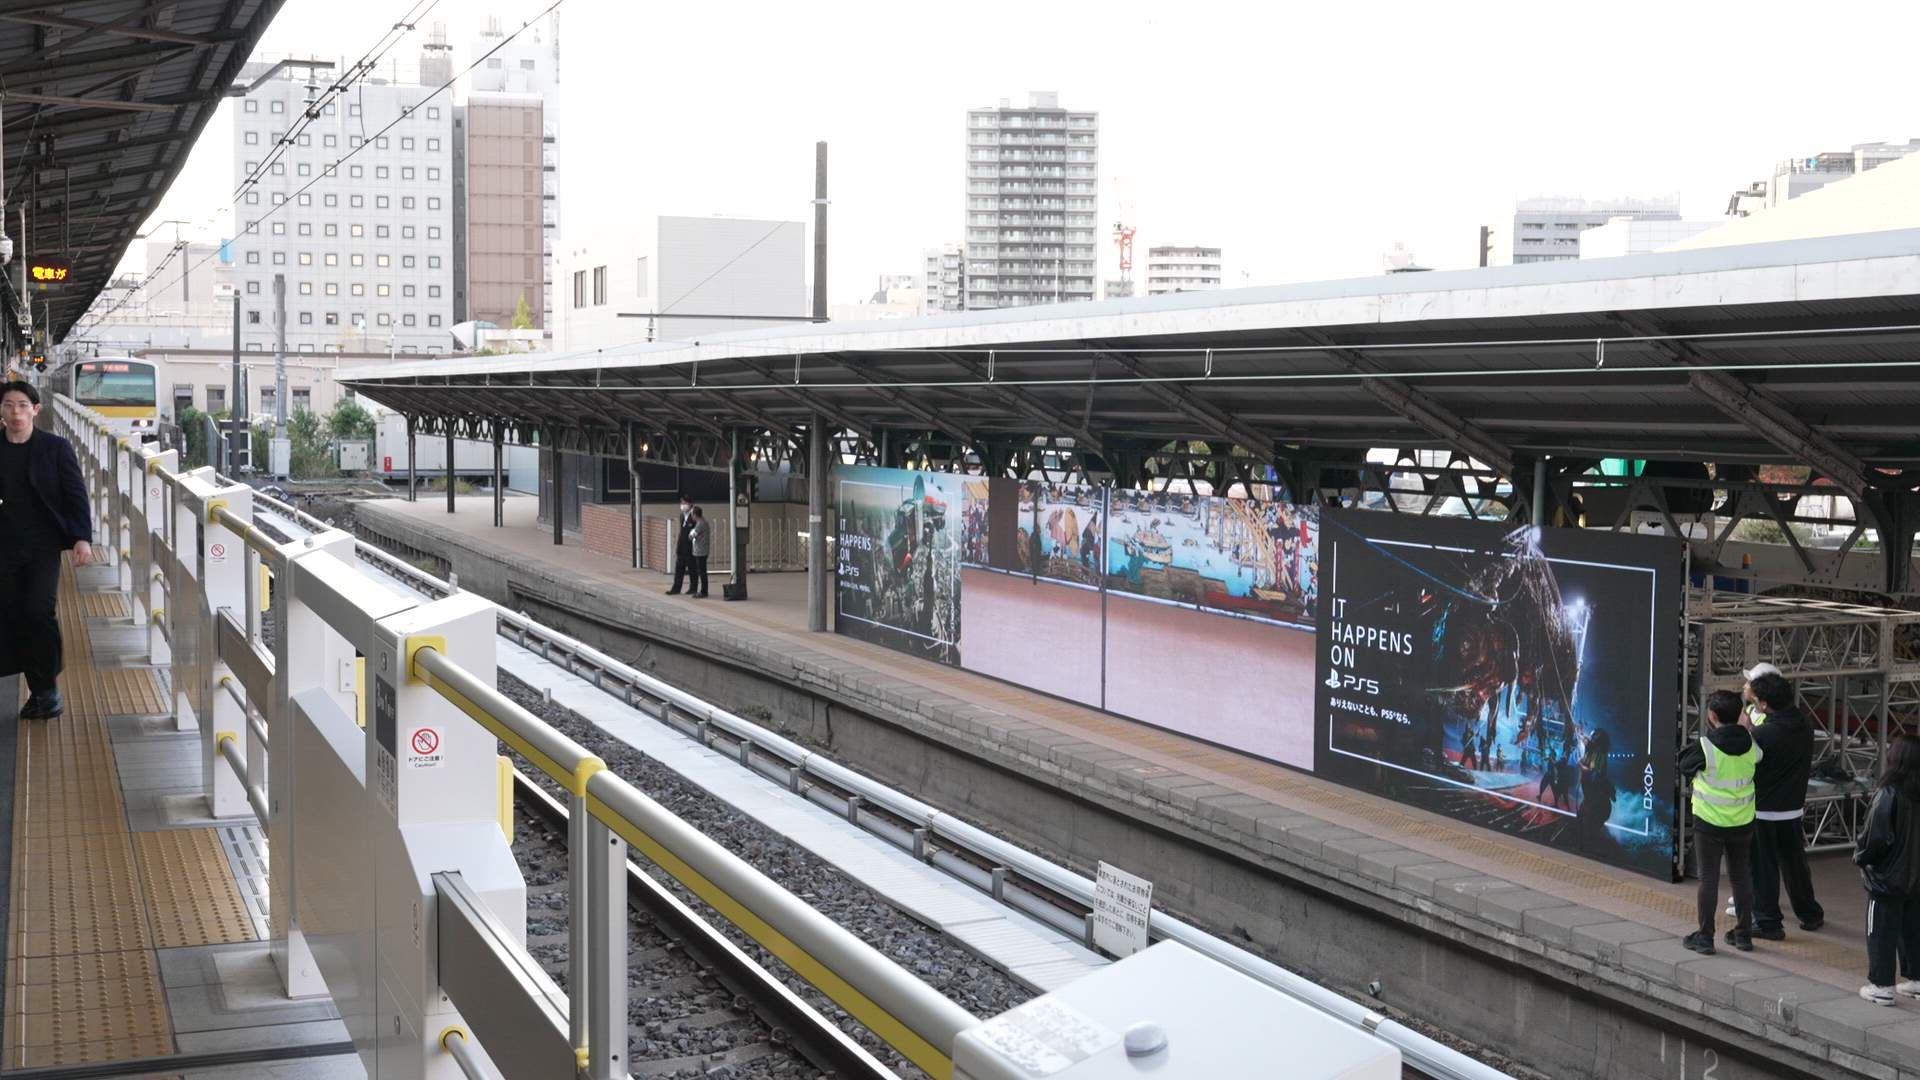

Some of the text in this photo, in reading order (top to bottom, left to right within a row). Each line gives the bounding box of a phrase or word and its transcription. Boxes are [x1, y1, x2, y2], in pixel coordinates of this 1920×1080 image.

[32, 266, 67, 280] 電車が
[840, 518, 846, 531] IT
[840, 532, 871, 551] HAPPENS
[840, 547, 850, 561] ON
[1332, 597, 1347, 618] IT
[1331, 621, 1413, 655] HAPPENS
[1331, 644, 1355, 669] ON
[1343, 674, 1379, 695] PS5
